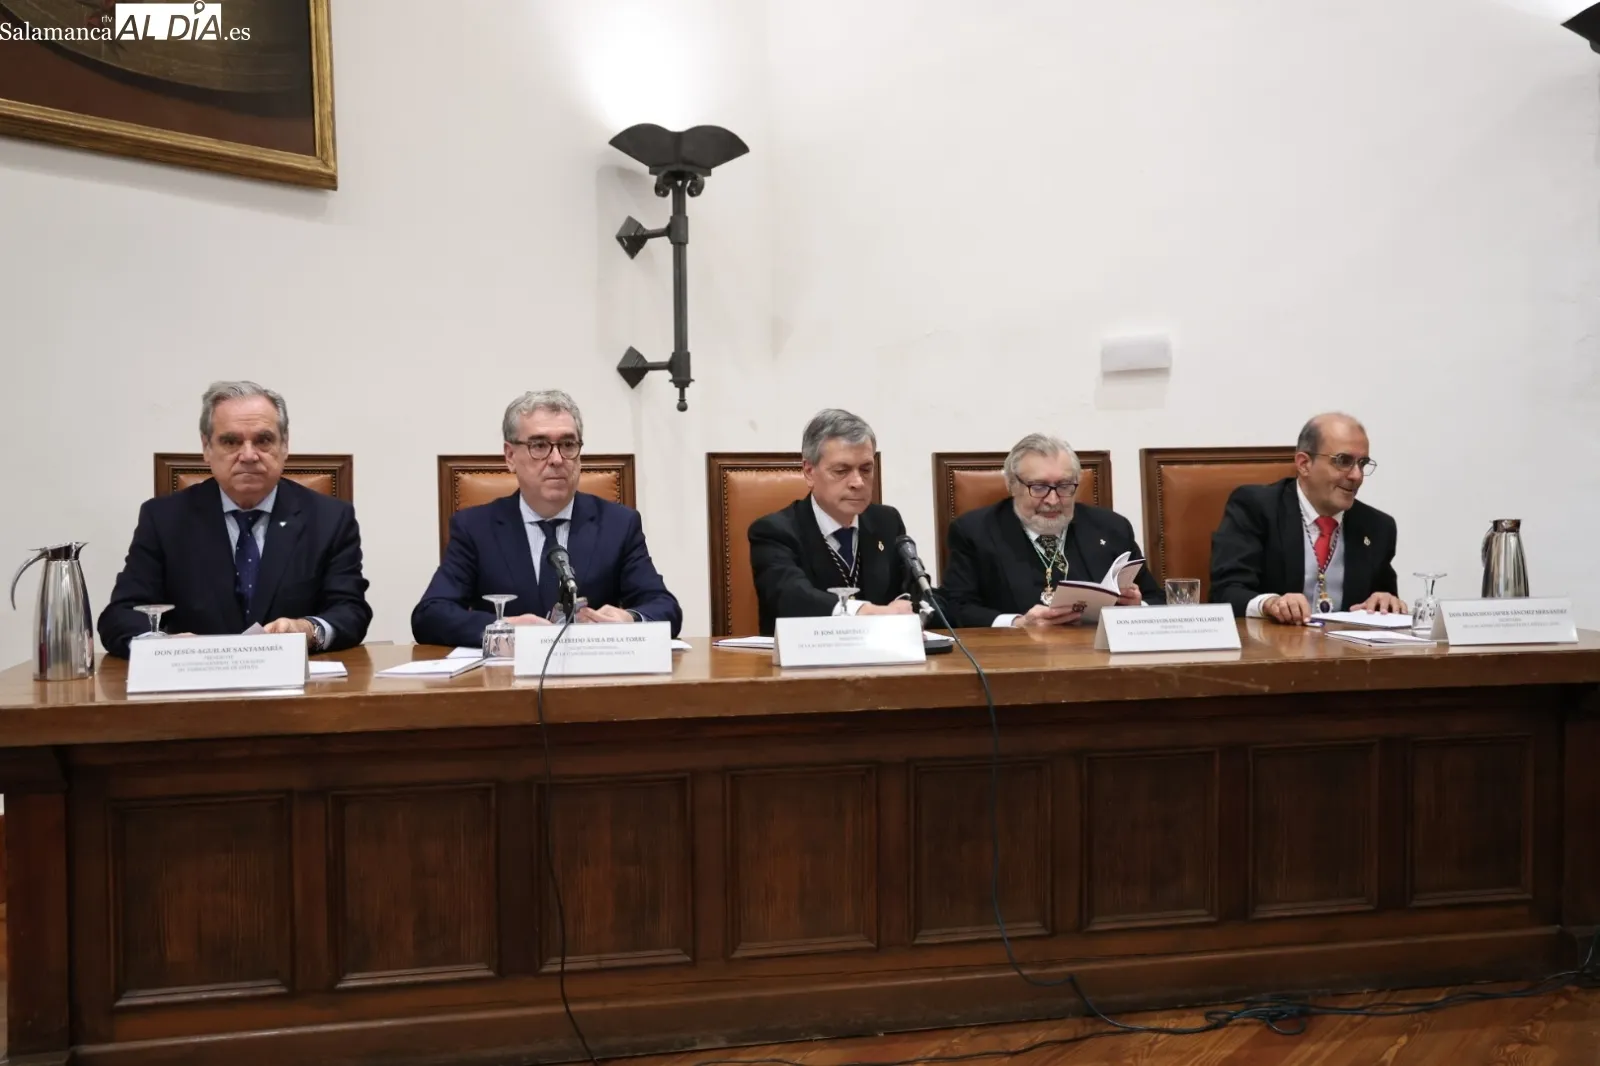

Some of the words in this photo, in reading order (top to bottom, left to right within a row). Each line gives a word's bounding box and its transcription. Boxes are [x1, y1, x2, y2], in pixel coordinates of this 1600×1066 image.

[154, 648, 172, 656] DON
[173, 647, 196, 656] JESÚS
[197, 646, 232, 655] AGUILAR
[232, 645, 284, 653] SANTAMARÍA
